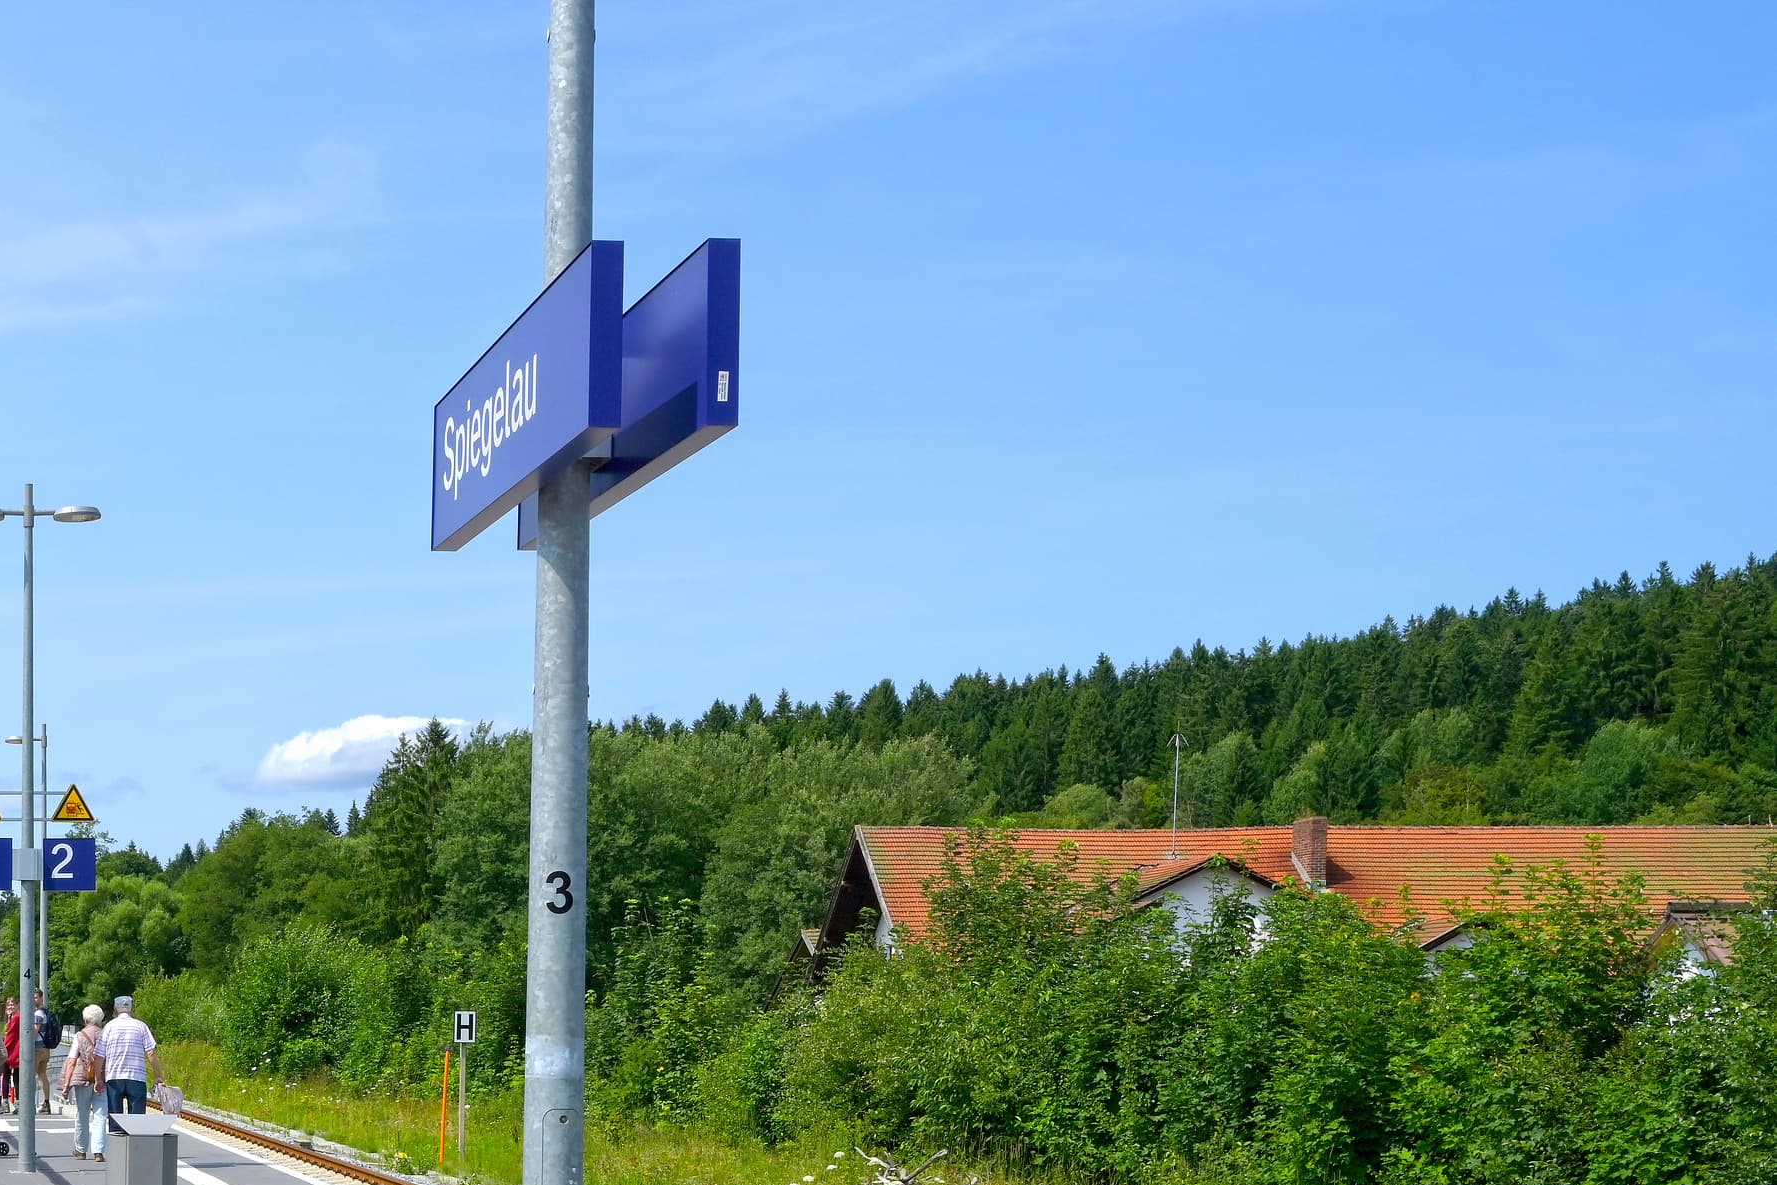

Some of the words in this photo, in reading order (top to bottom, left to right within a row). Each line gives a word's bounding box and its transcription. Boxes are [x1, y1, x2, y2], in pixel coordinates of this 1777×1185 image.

[443, 353, 537, 501] Spiegelau
[51, 843, 74, 879] 2
[546, 870, 573, 915] 3
[23, 968, 32, 980] 4
[456, 1013, 473, 1040] H
